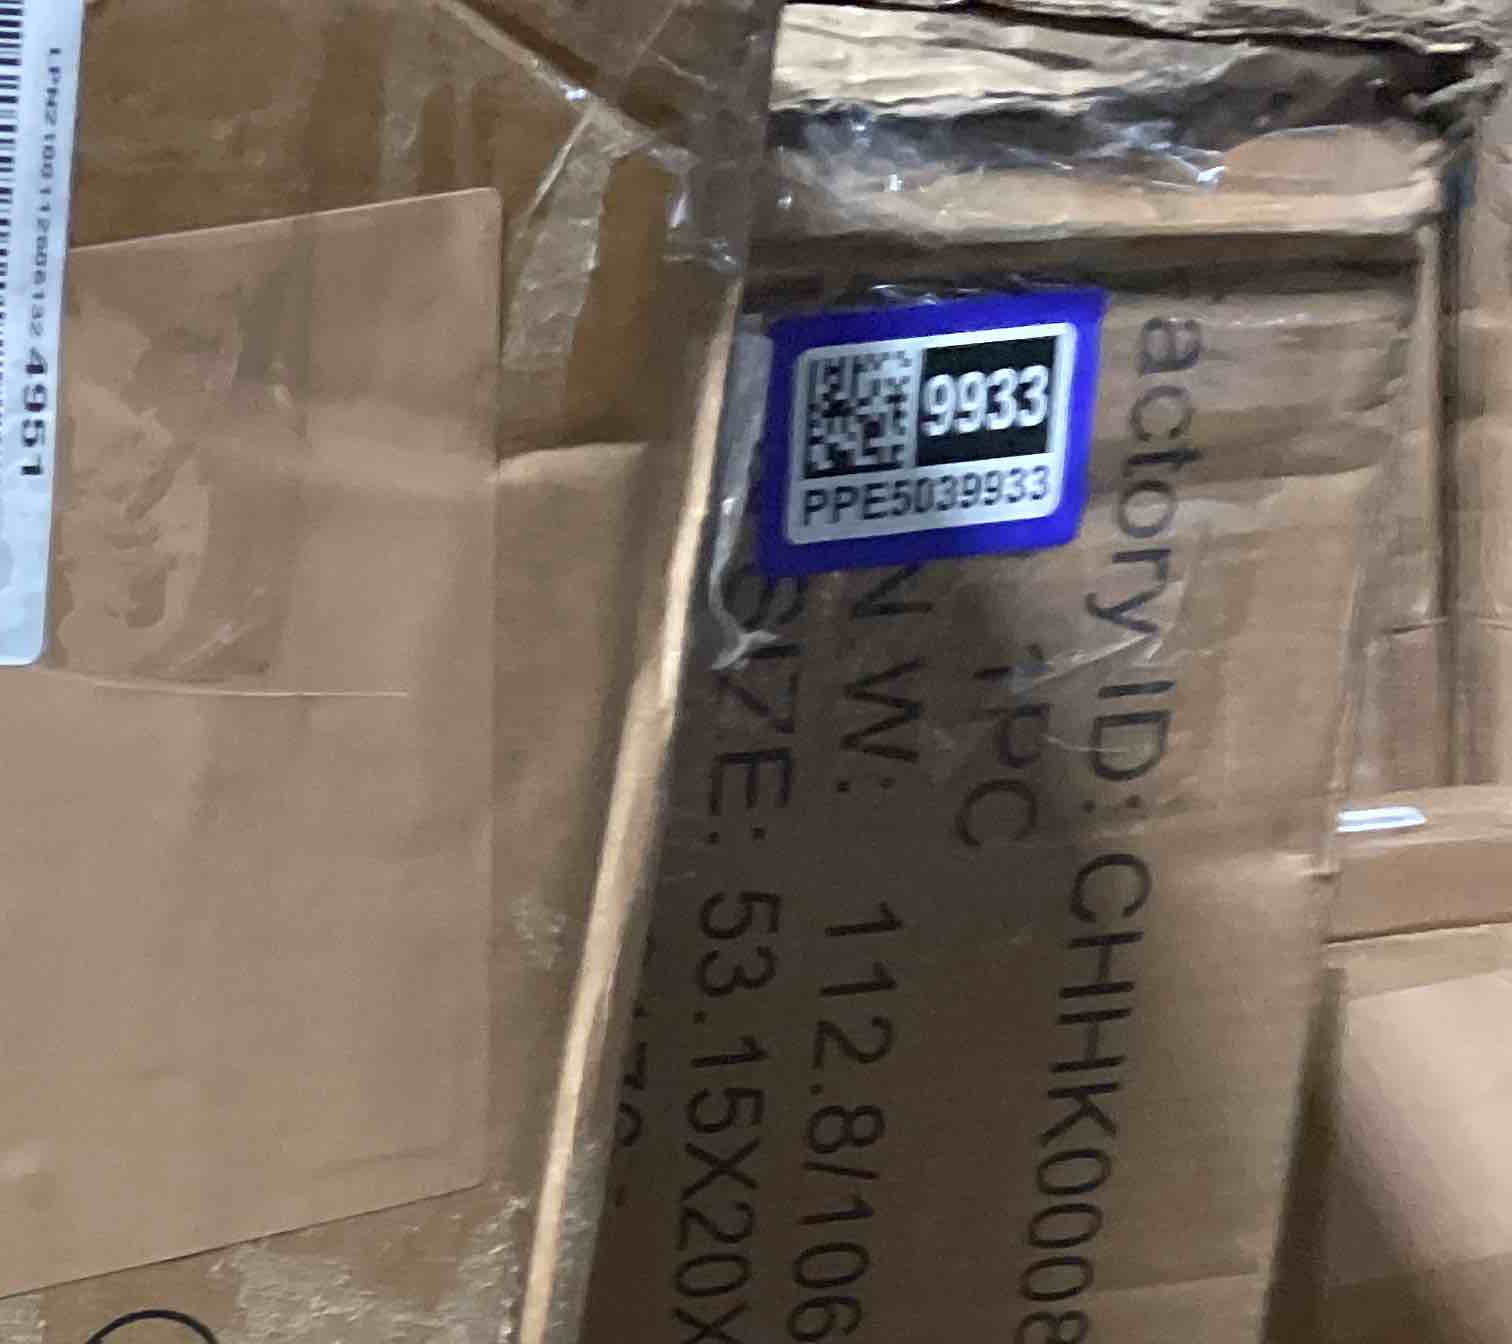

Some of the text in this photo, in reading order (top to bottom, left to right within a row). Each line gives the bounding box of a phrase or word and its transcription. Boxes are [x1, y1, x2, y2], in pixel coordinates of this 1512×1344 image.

[922, 366, 1049, 437] 9933
[802, 464, 1050, 528] PPE5039933
[1085, 679, 1177, 812] ID:
[791, 901, 903, 1344] 112.8/106
